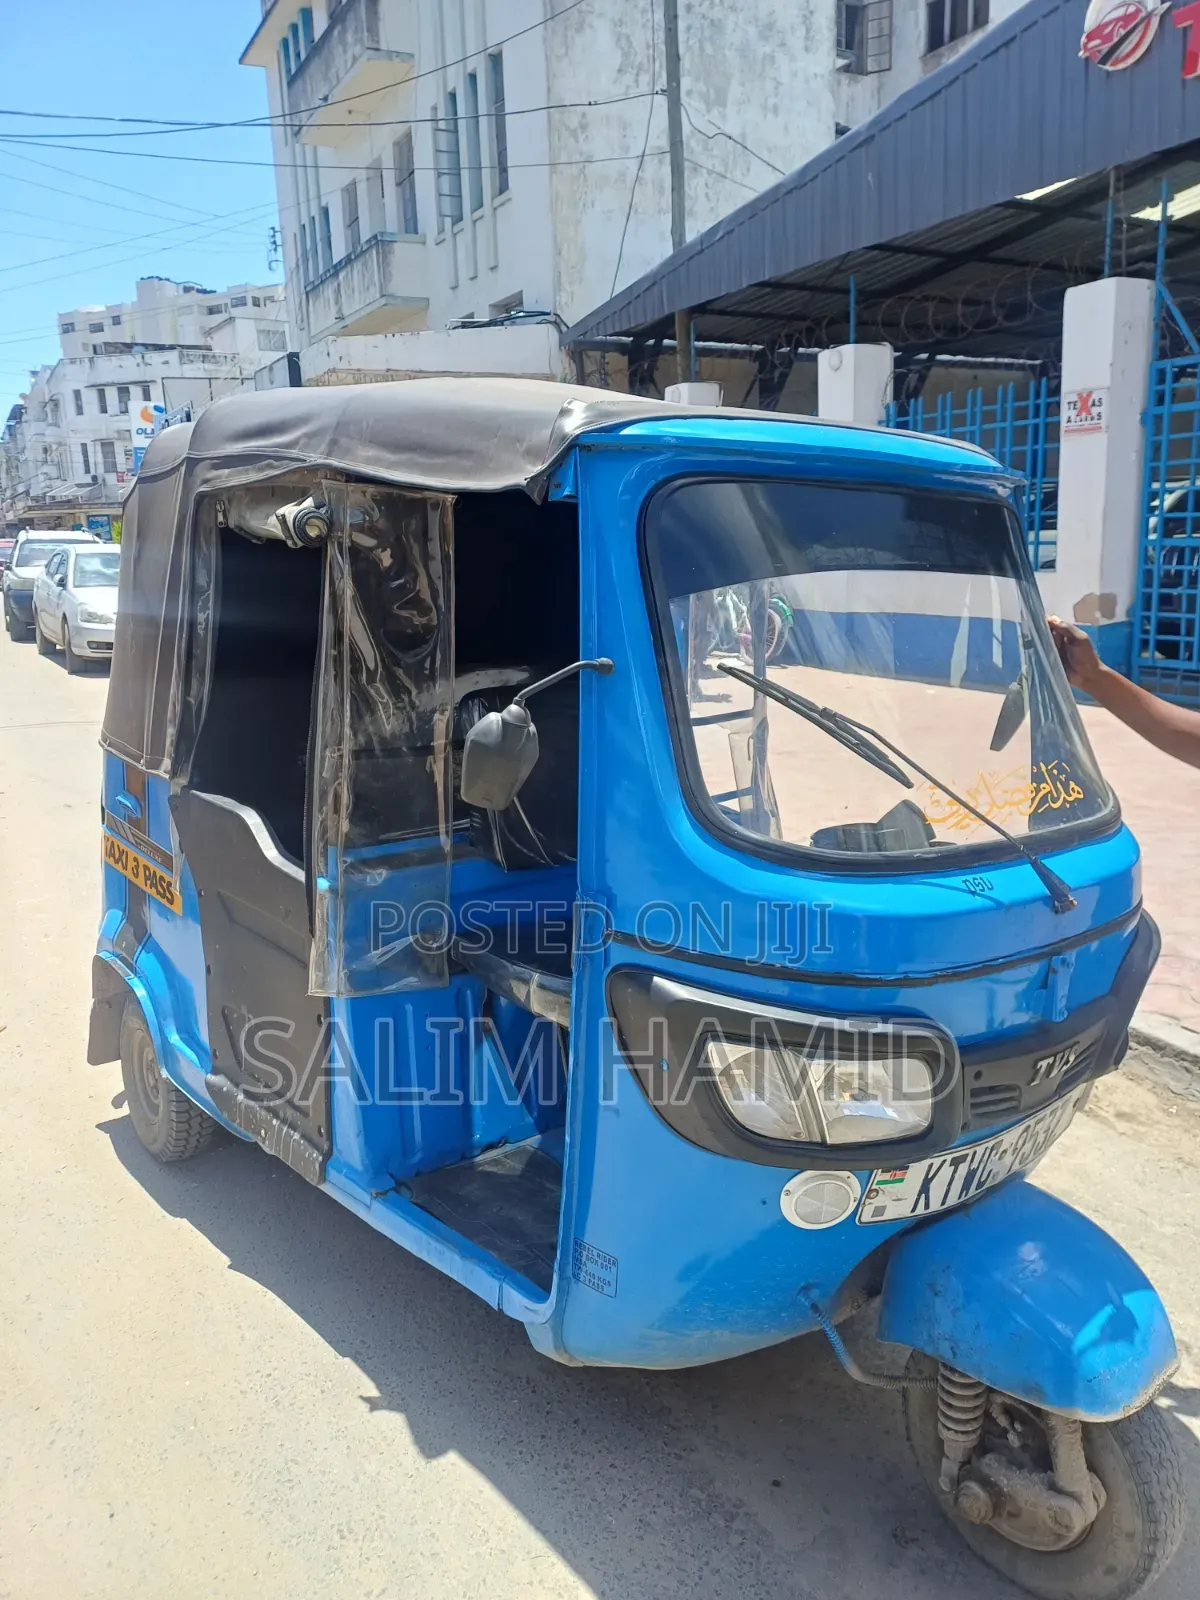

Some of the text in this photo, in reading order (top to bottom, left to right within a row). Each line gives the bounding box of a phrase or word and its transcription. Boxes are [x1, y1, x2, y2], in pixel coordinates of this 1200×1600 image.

[1067, 391, 1103, 416] TEXAS
[104, 835, 175, 906] TAXI 3 PASS
[1027, 1040, 1080, 1087] TVS
[910, 1138, 1004, 1214] KTWC
[597, 1254, 616, 1267] RIDER
